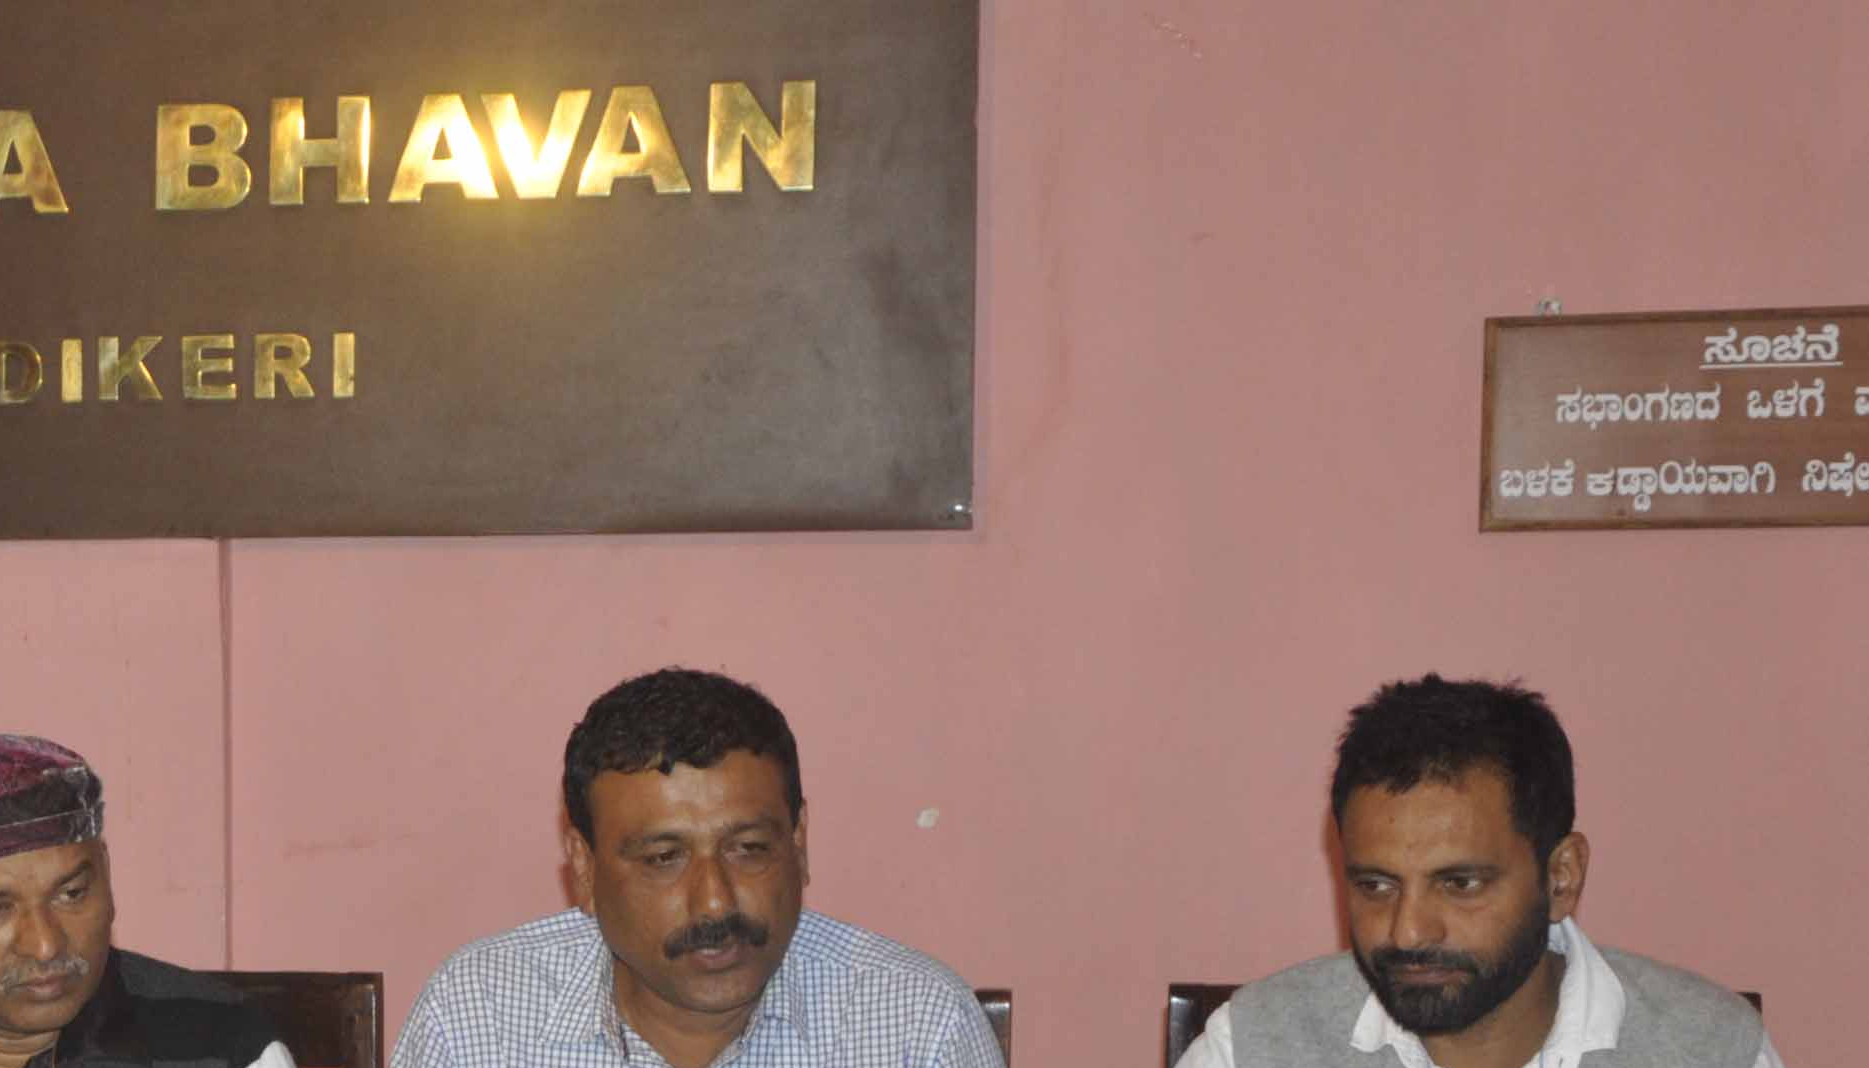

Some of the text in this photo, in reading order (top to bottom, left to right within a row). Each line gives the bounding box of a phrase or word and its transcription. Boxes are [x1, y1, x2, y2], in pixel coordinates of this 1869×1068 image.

[154, 79, 819, 211] BHAVAN
[1703, 323, 1840, 363] ಸೂಚನೆ
[1555, 382, 1721, 431] ಸಭಾಂಗಣದ
[1746, 378, 1825, 419] ಒಳಗೆ
[1499, 459, 1575, 497] ಬಳಕೆ
[1586, 459, 1777, 512] ಕಡ್ಡಾಯವಾಗಿ
